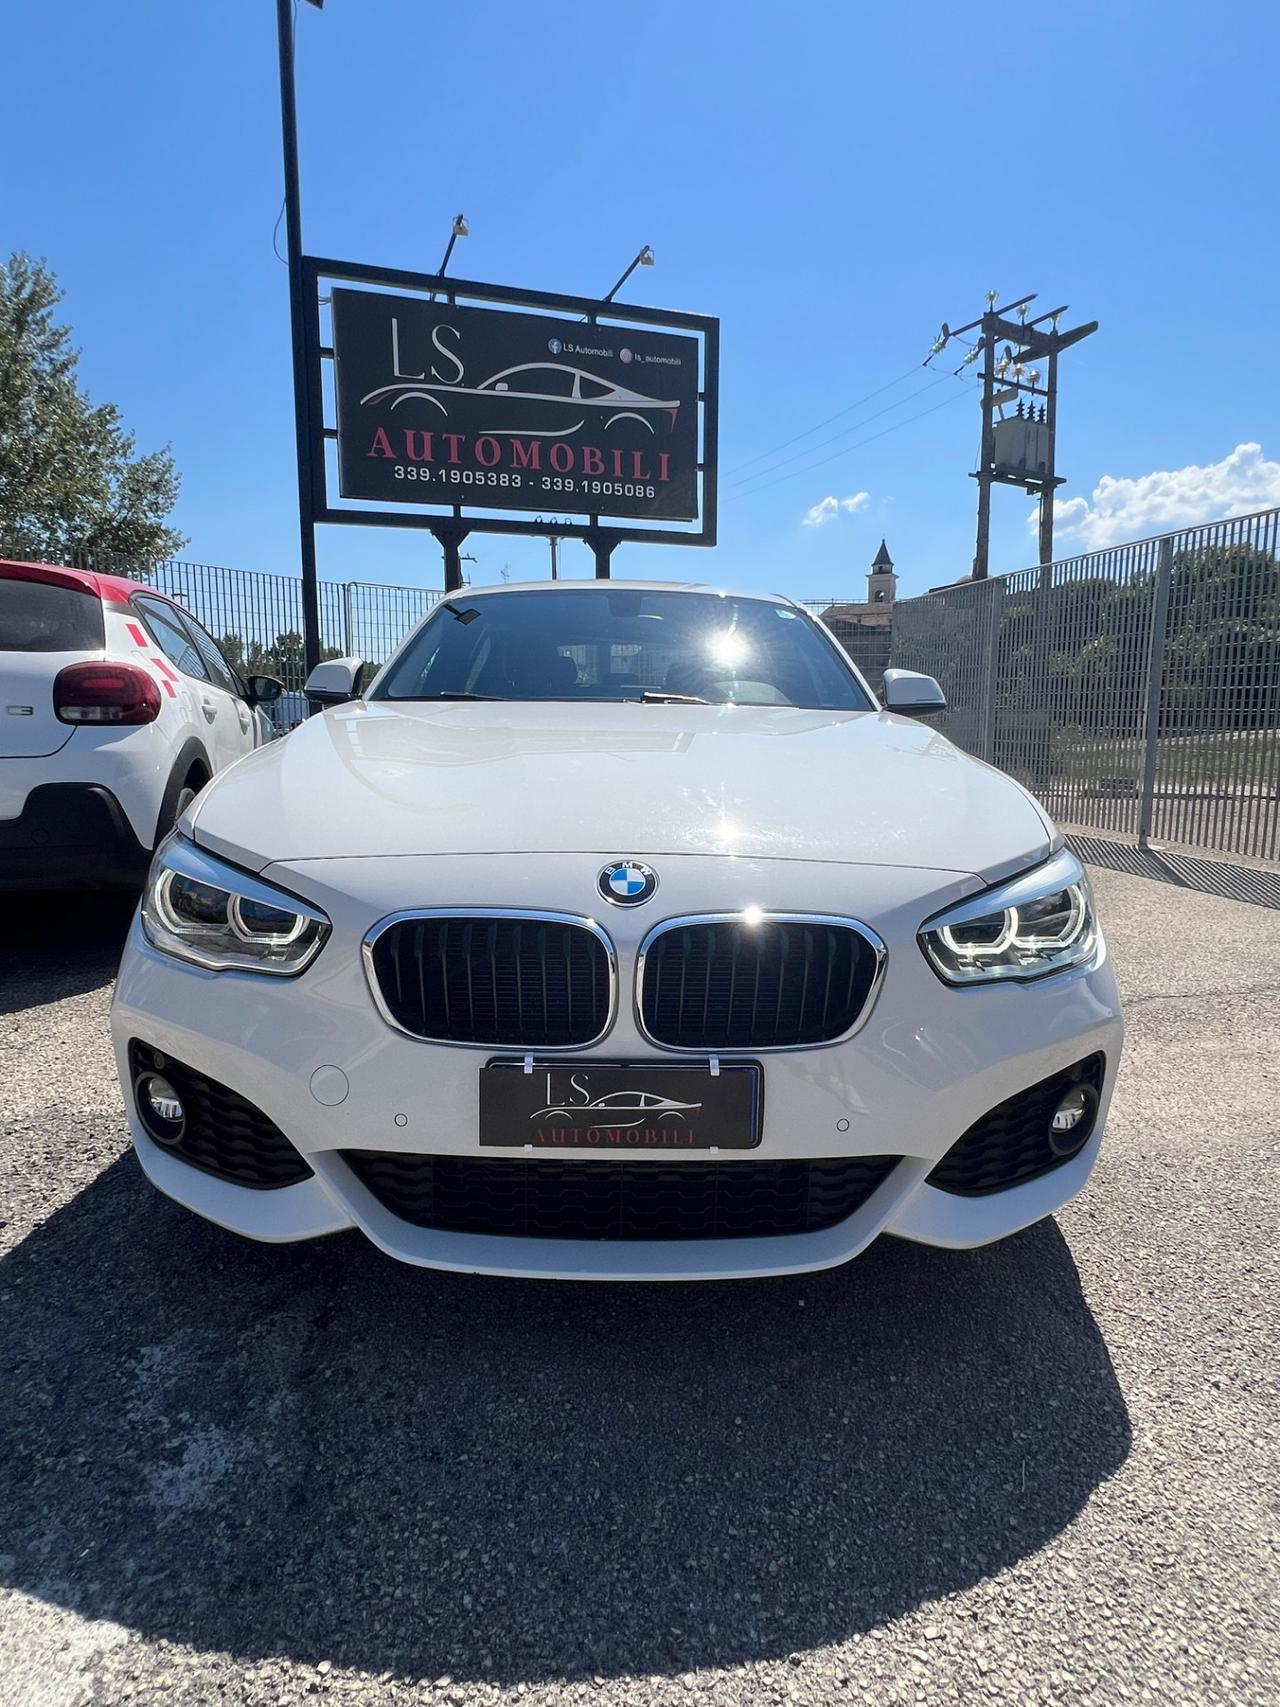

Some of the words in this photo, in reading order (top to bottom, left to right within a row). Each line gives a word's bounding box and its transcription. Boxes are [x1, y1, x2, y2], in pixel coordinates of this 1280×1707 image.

[391, 317, 465, 385] LS
[563, 343, 574, 352] LS
[575, 345, 614, 357] Automobili
[366, 426, 670, 481] AUTOMOBILI
[394, 465, 522, 488] 339.1905383
[541, 476, 656, 499] 339.1905086
[604, 861, 653, 876] BMW
[546, 1073, 590, 1106] LS
[534, 1127, 697, 1145] AUTOMOBILI
